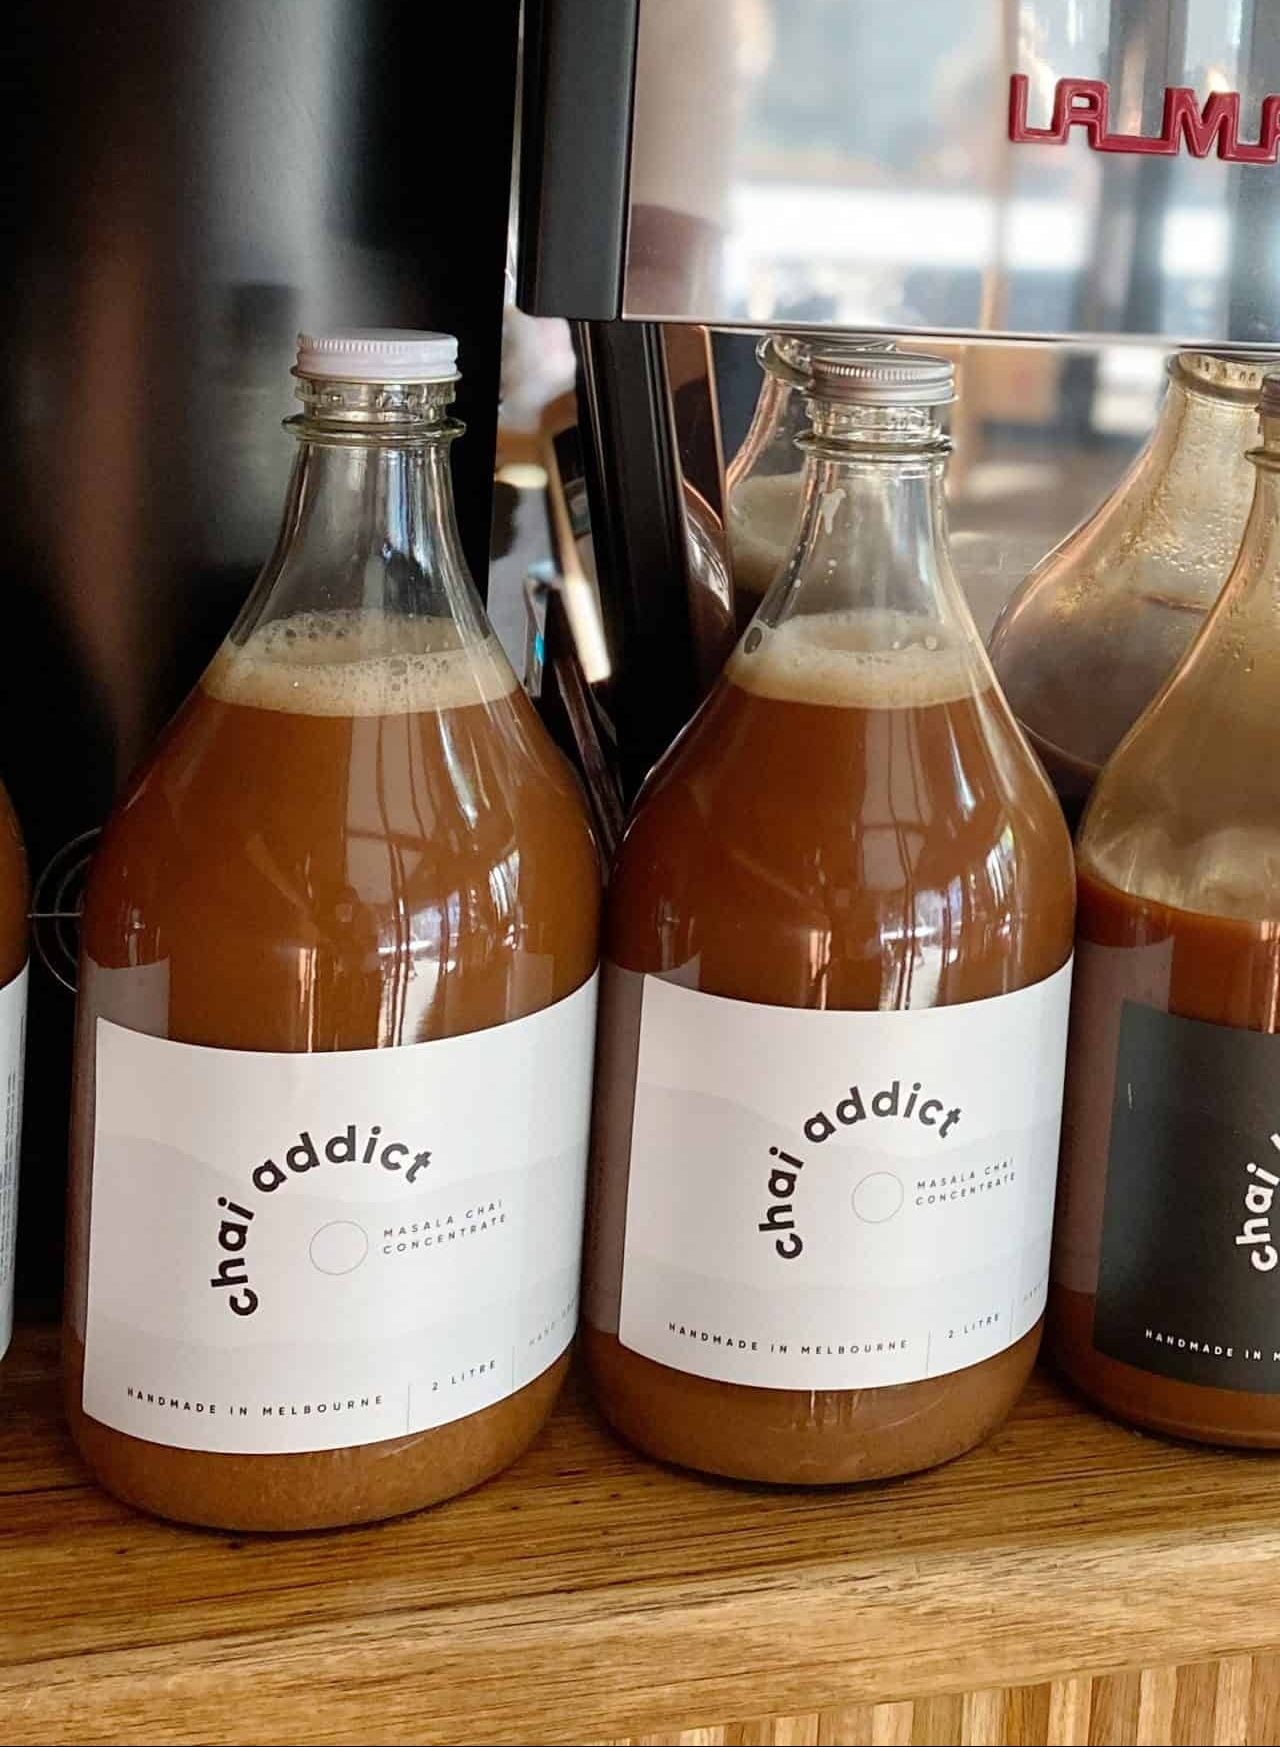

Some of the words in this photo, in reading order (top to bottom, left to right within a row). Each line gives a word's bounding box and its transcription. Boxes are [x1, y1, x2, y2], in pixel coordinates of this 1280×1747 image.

[1009, 74, 1110, 147] LA
[758, 1146, 805, 1260] chai
[803, 1080, 962, 1143] addict
[915, 1172, 1015, 1206] CONCENTRATE
[917, 1171, 975, 1190] MASALA
[984, 1157, 1014, 1175] CHAI
[210, 1196, 258, 1317] chai
[252, 1125, 433, 1196] addict
[383, 1215, 454, 1238] MASALA
[465, 1199, 502, 1219] CHAI
[383, 1214, 505, 1254] CONCENTRATE
[1235, 1162, 1280, 1272] chai
[668, 1322, 758, 1351] HANDMADE
[770, 1343, 788, 1355] IN
[801, 1340, 908, 1355] MELBOURNE
[964, 1313, 1000, 1335] LITRE
[1145, 1329, 1233, 1358] HANDMADE
[1245, 1349, 1261, 1361] IN
[127, 1388, 218, 1416] HANDMADE
[229, 1405, 249, 1417] IN
[262, 1395, 385, 1418] MELBOURNE
[450, 1359, 497, 1386] LITRE
